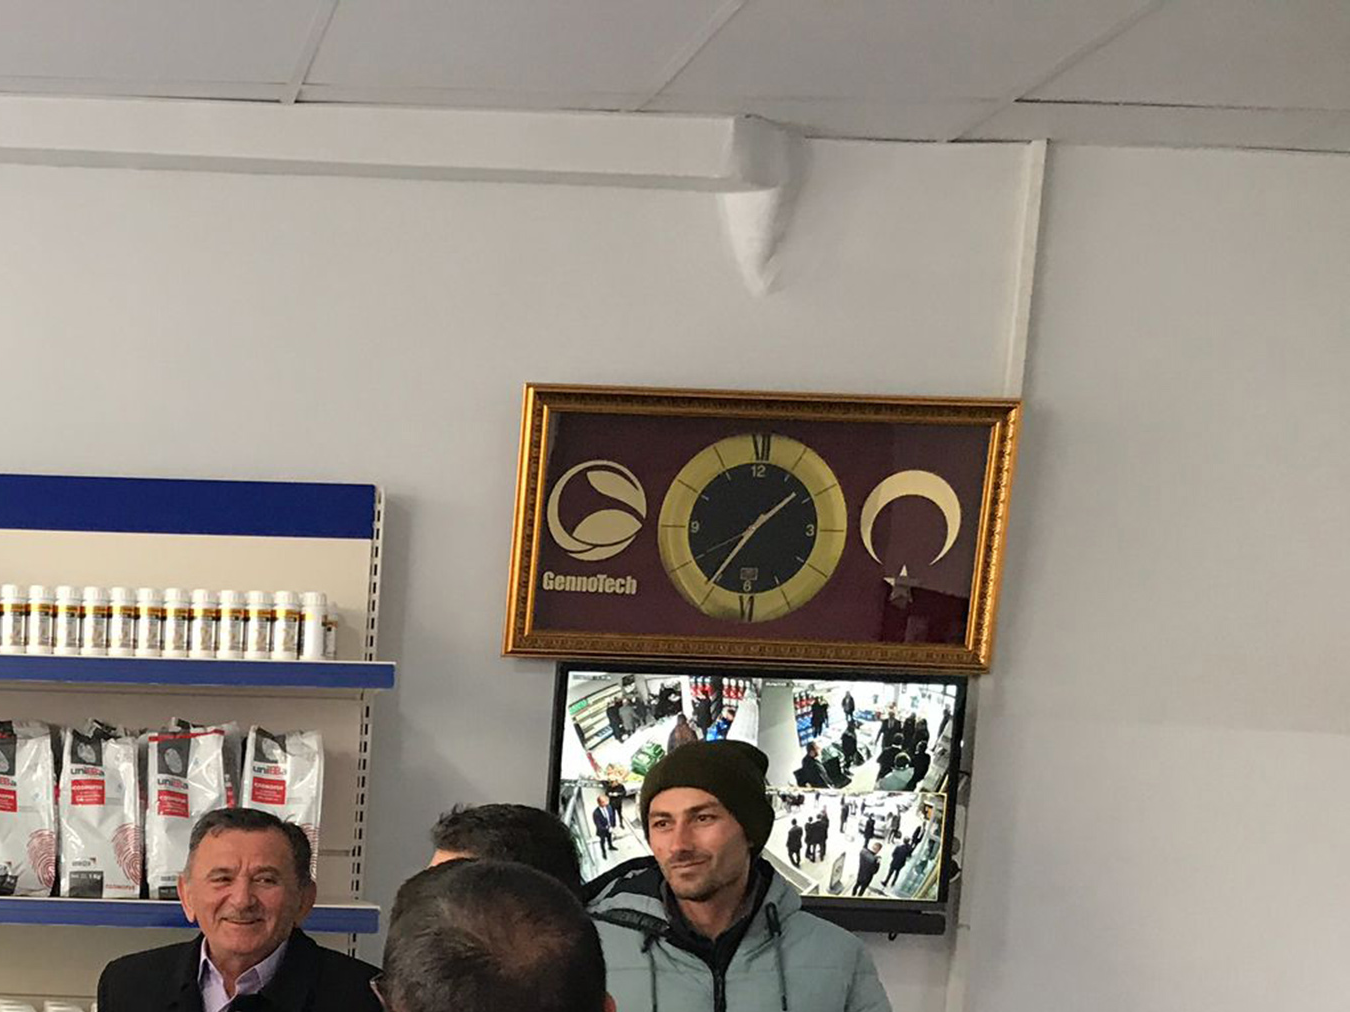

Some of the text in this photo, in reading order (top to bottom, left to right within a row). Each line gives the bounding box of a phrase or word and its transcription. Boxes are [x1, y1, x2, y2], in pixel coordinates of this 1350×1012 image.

[751, 464, 766, 478] 12
[691, 520, 700, 533] 9
[805, 524, 815, 537] 3
[542, 571, 637, 595] GennoTech
[742, 579, 752, 592] 6
